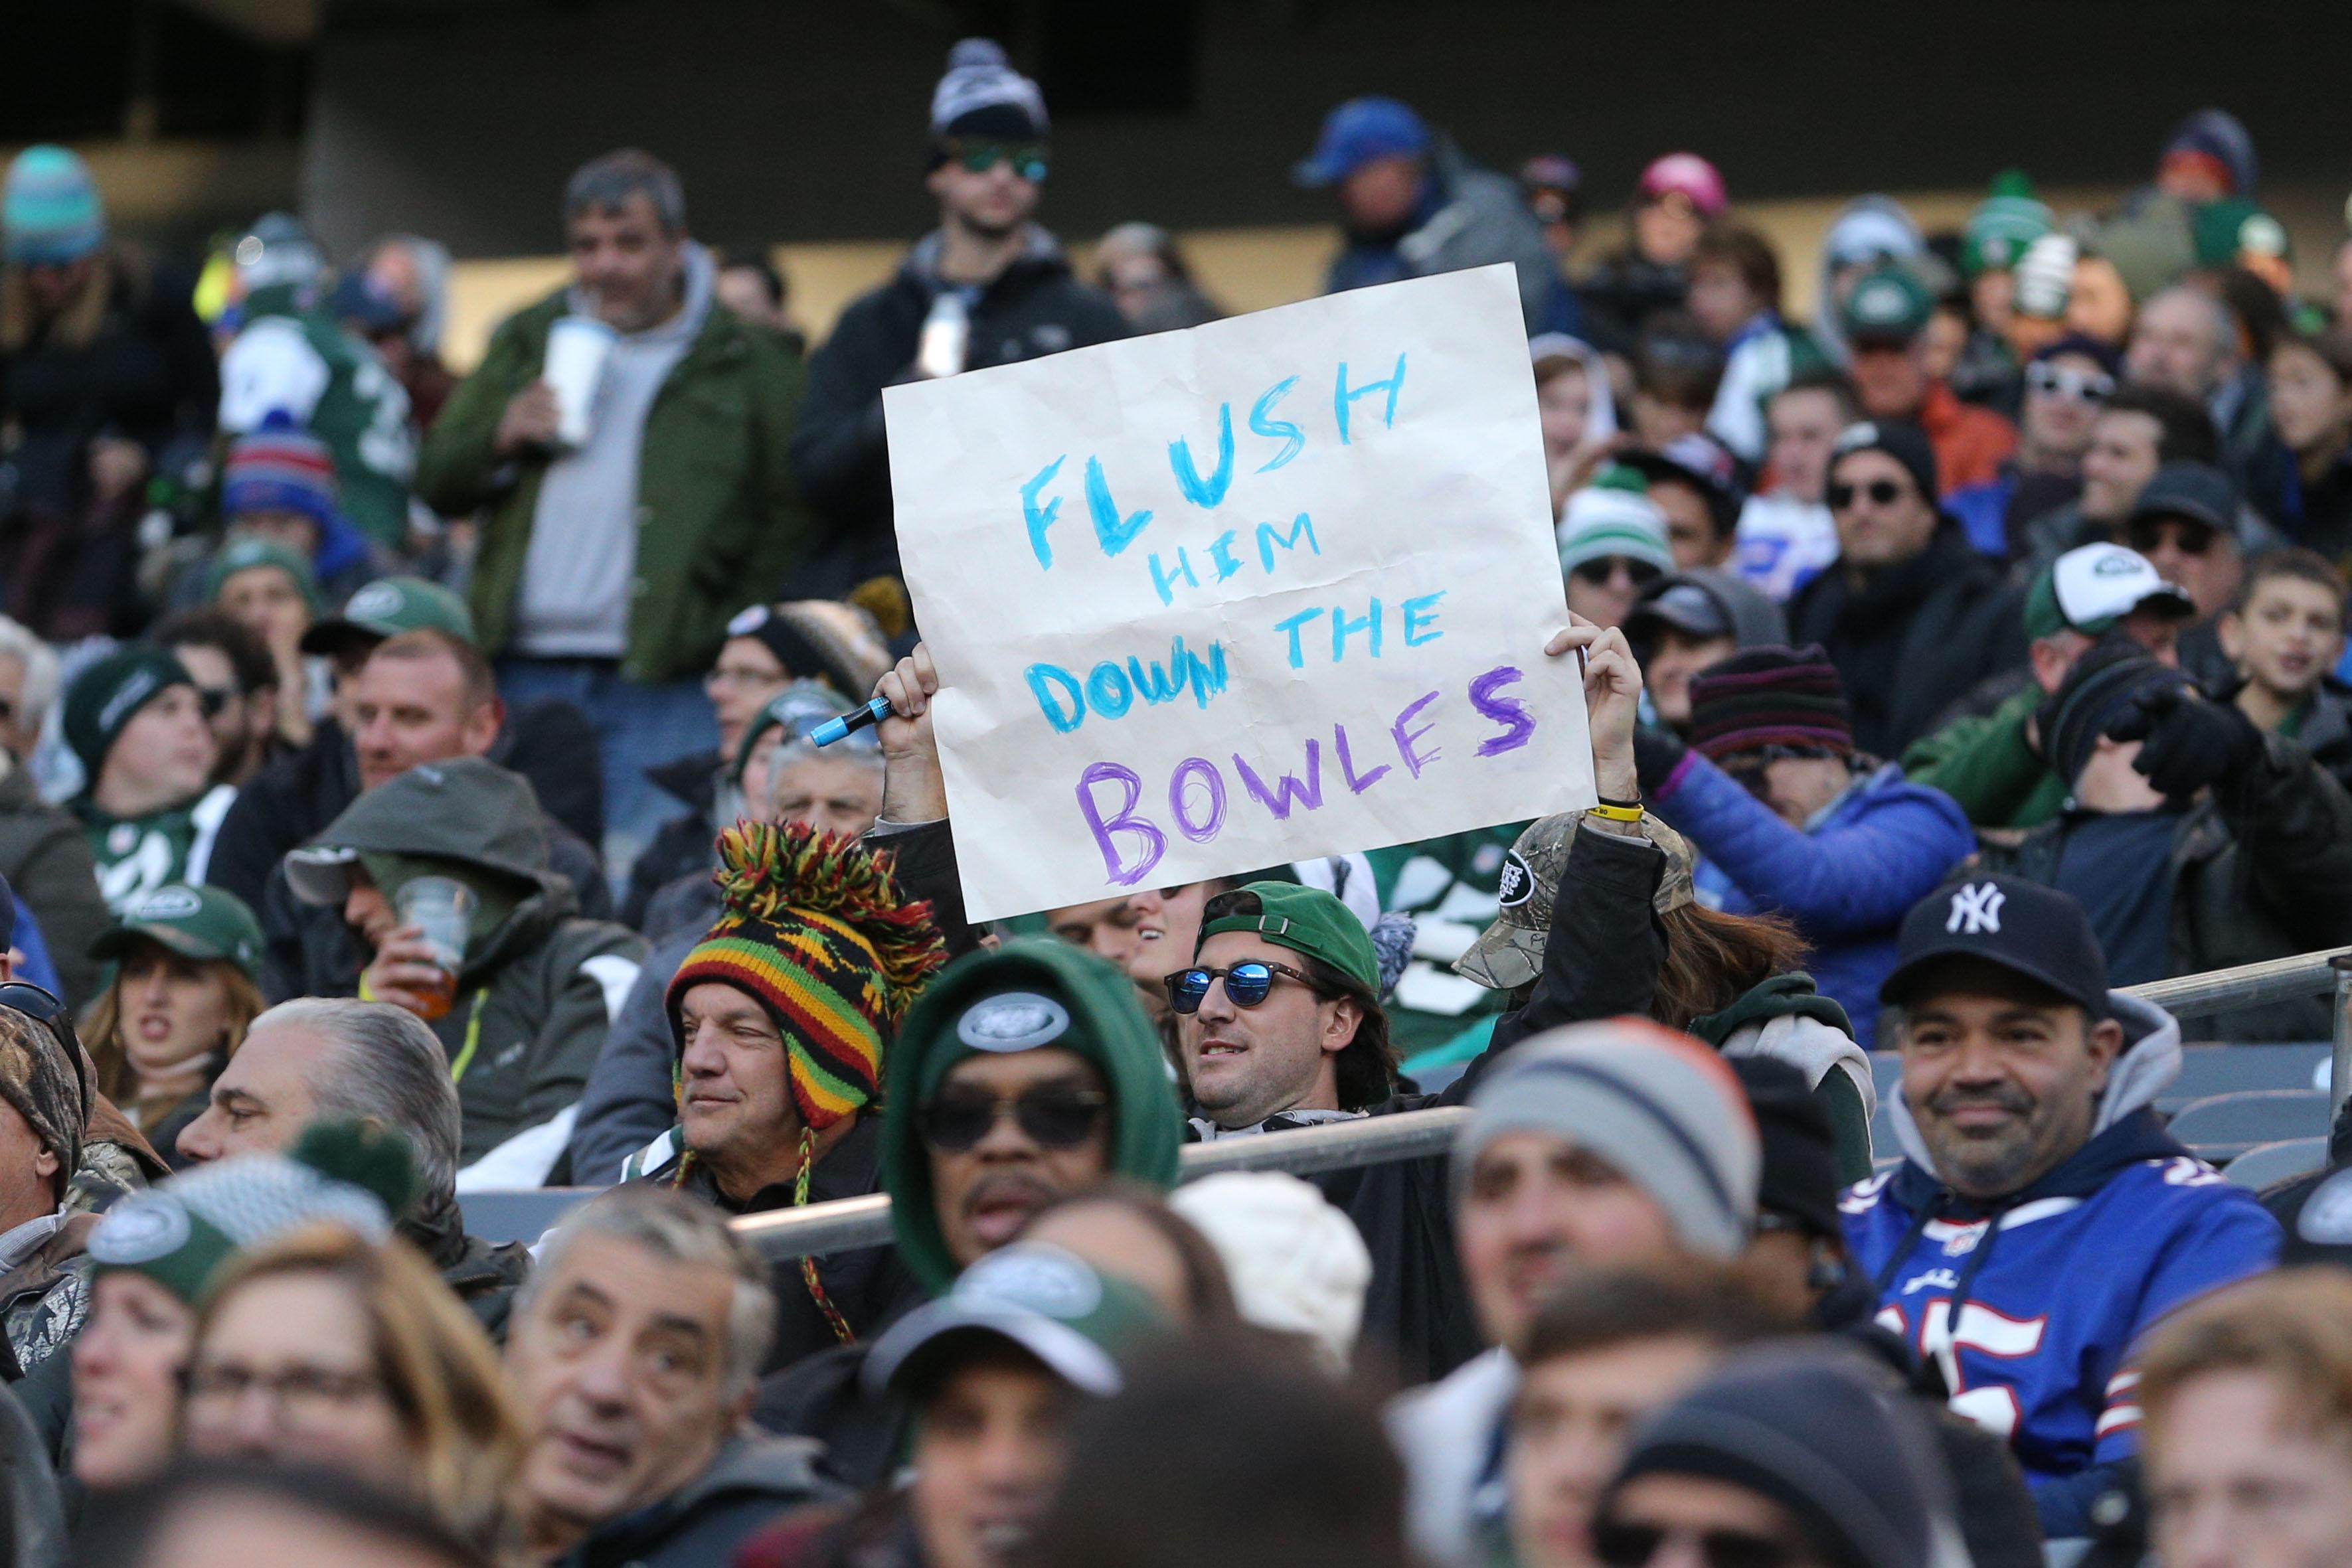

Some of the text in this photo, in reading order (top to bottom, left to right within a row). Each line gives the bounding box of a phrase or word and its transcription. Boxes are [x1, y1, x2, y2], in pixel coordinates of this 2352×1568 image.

[1020, 351, 1406, 571] FLUSH
[1148, 512, 1321, 606] HIM
[1024, 590, 1446, 734] DOWN THE
[1076, 666, 1537, 886] BOWLES
[1945, 882, 2005, 934] NY
